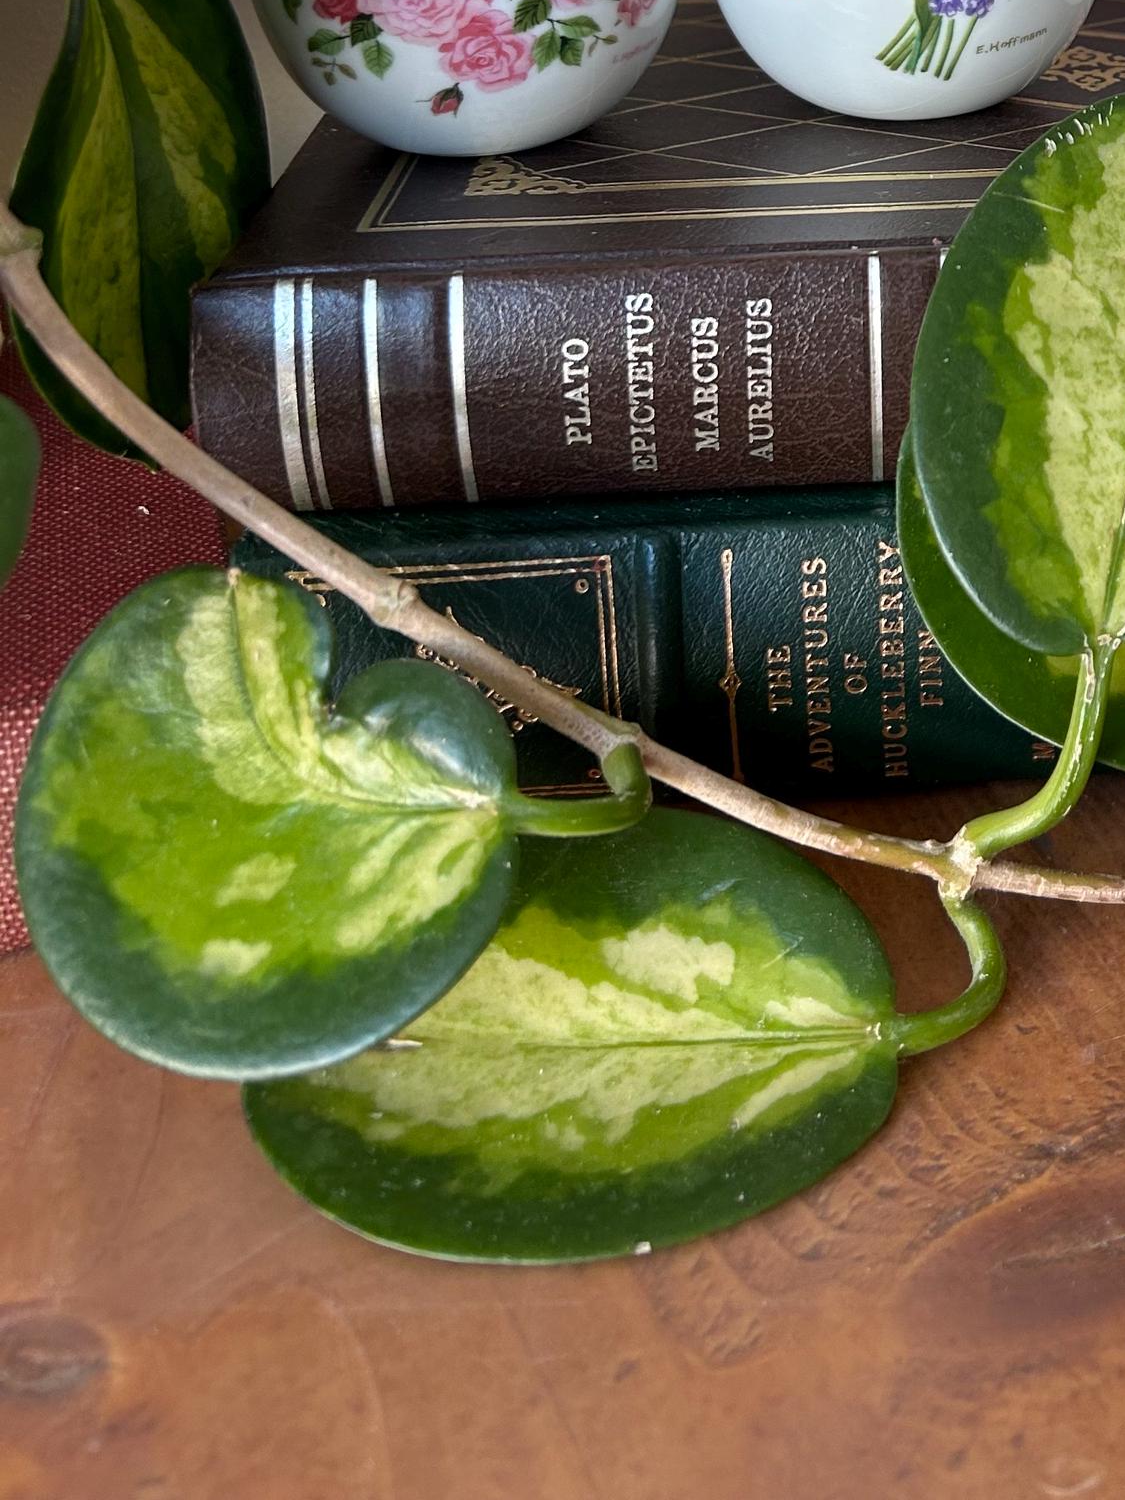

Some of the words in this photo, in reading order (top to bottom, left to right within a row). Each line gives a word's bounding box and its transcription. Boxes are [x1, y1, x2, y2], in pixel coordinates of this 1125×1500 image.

[563, 337, 593, 446] PLATO
[625, 291, 660, 473] EPICTETUS
[690, 316, 720, 453] MARCUS
[746, 297, 774, 463] AURELIUS
[767, 643, 793, 714] THE
[801, 556, 835, 774] ADVENTURES
[843, 652, 869, 695] OF
[877, 539, 910, 778] HUCKLEBERRY
[917, 629, 945, 708] FINN
